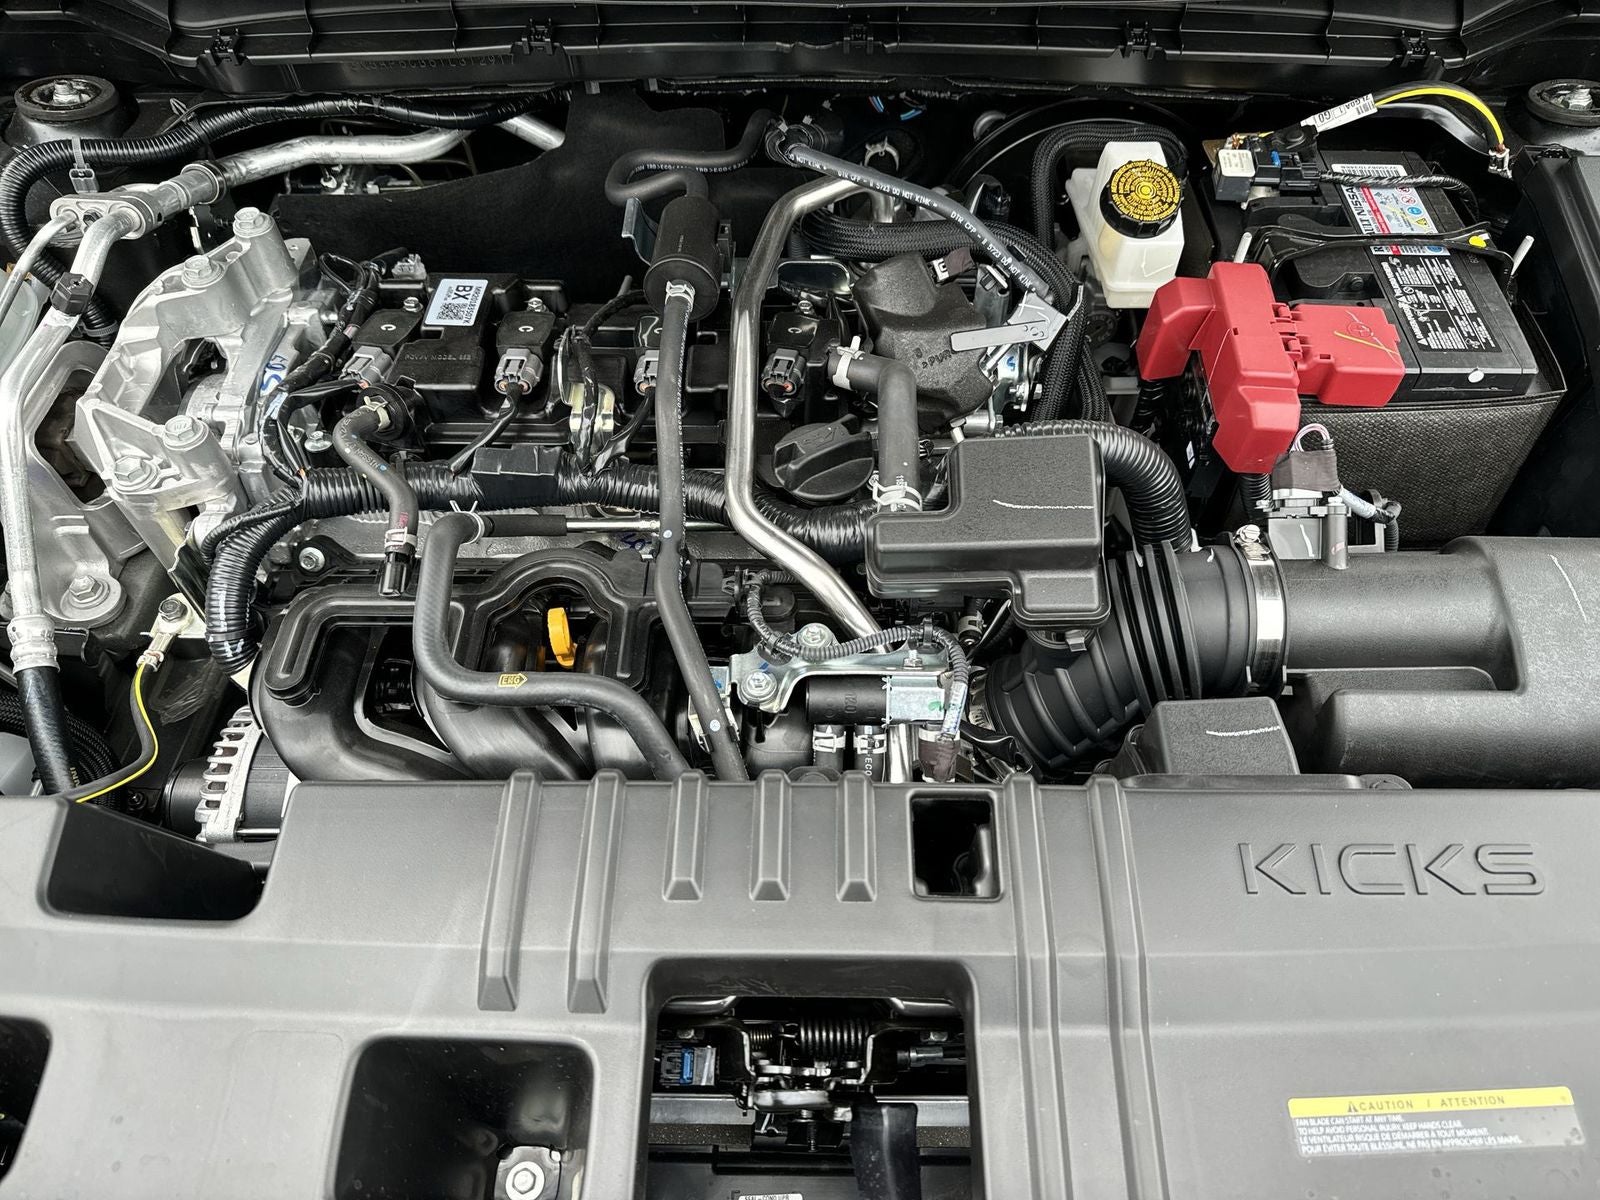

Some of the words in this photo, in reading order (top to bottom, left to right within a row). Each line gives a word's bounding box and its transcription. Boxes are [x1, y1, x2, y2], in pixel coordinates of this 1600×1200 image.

[1345, 186, 1367, 216] NISSA
[950, 211, 964, 224] DTR
[964, 222, 977, 233] CFP
[987, 243, 1002, 258] 5723
[1008, 264, 1020, 276] NOT
[1018, 274, 1032, 288] KINK
[451, 285, 474, 300] BX
[502, 676, 520, 685] ENG
[1238, 843, 1545, 895] KICKS
[1358, 1100, 1414, 1112] CAUTION
[1440, 1096, 1506, 1107] ATTENTION
